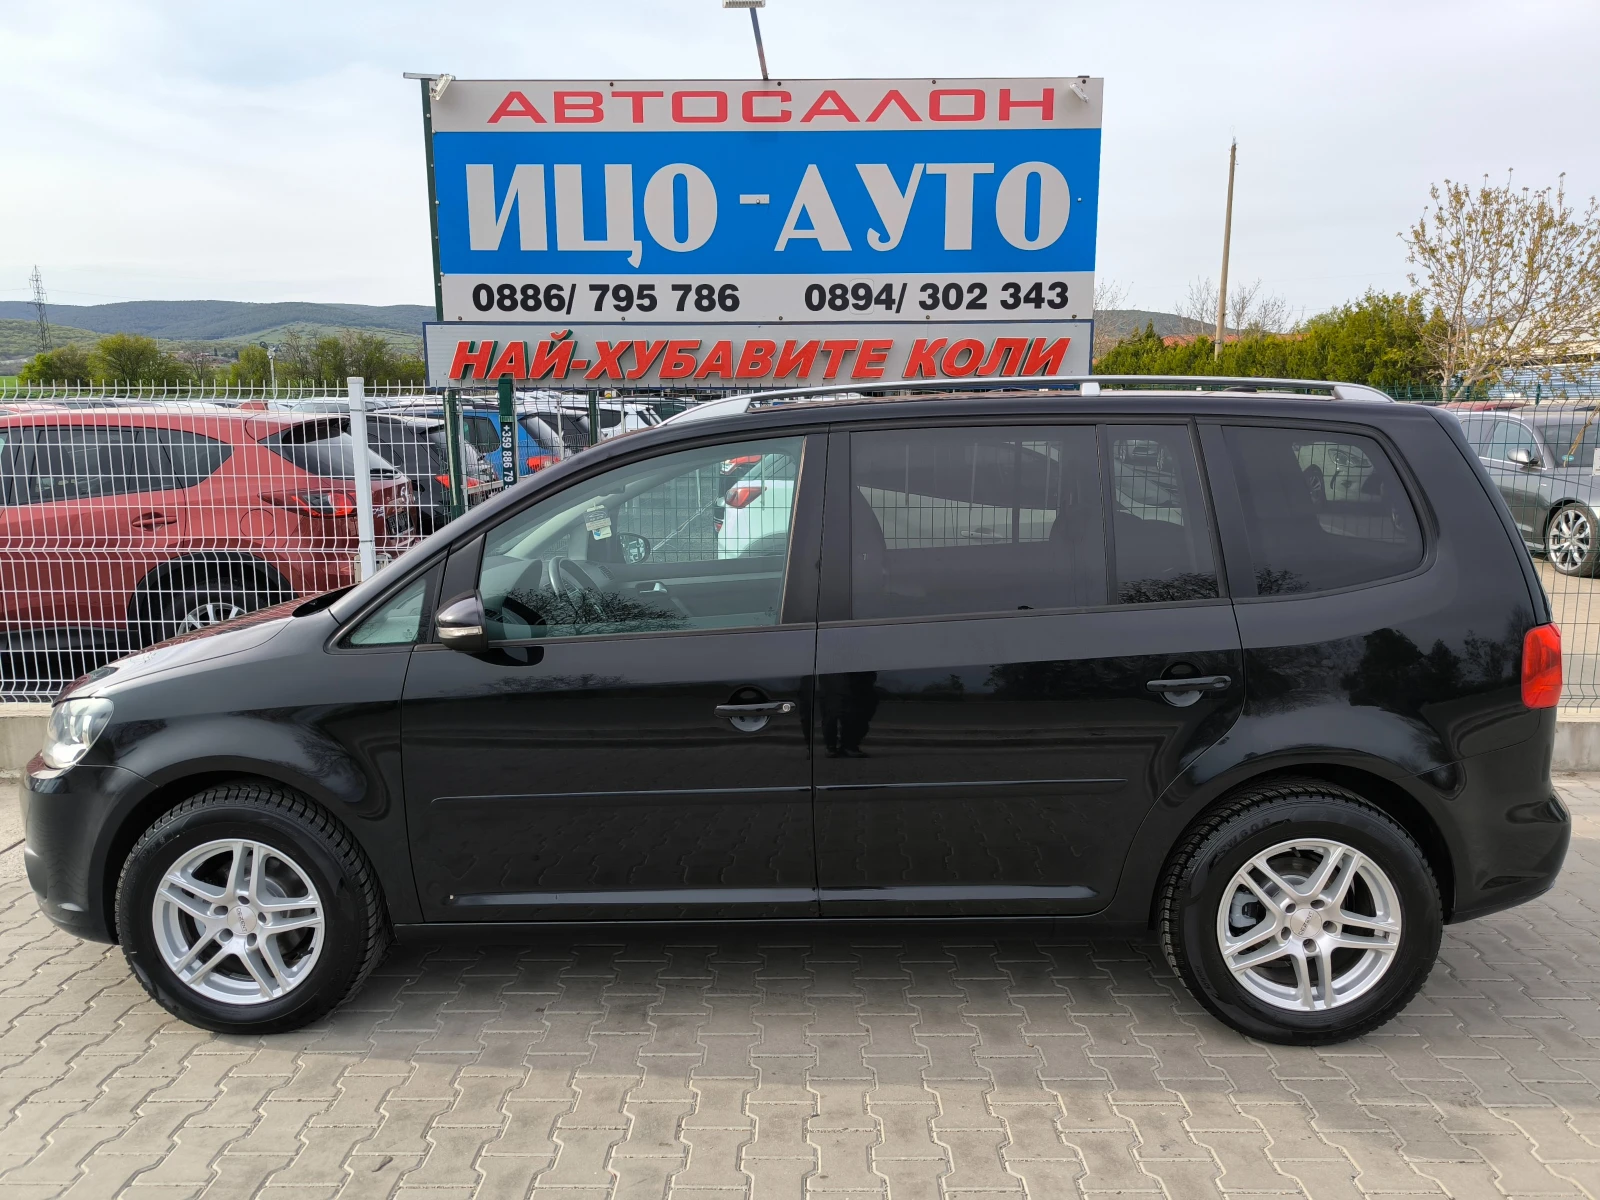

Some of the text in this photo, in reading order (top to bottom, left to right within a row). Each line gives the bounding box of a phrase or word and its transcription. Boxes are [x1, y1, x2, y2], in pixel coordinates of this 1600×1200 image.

[487, 88, 1055, 124] АВТОСАЛОН
[472, 283, 740, 315] 0886/ 795 786
[804, 281, 1069, 314] 0894/ 302 343
[449, 330, 1071, 380] НАЙ-ХУБАВИТЕ КОЛИ
[501, 424, 513, 449] +359
[502, 450, 513, 469] 886
